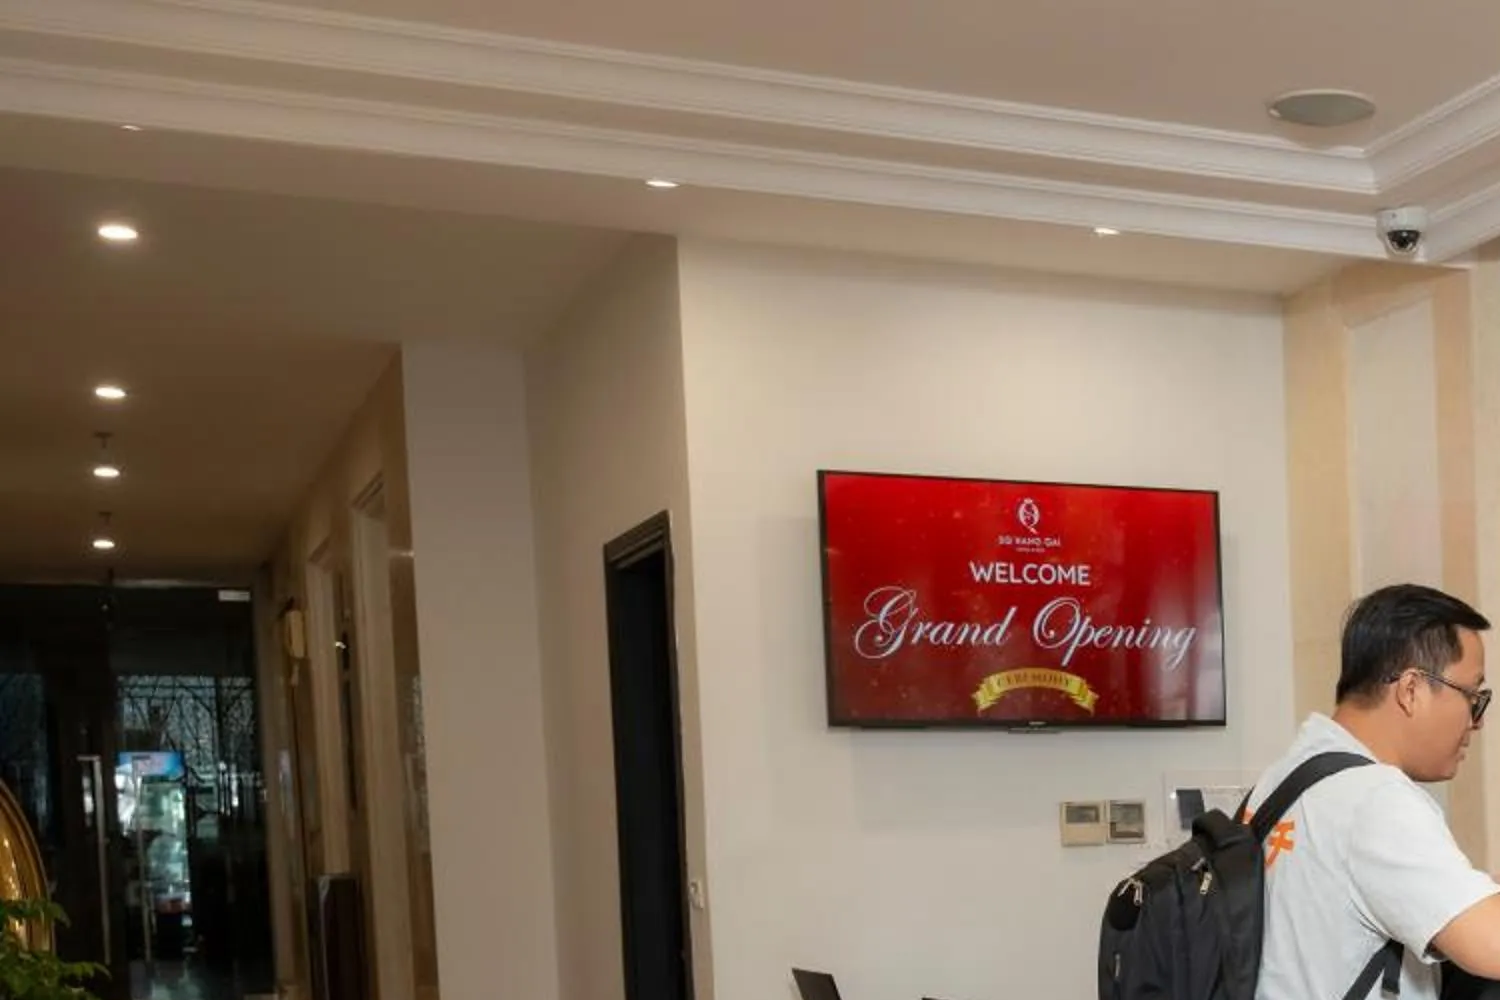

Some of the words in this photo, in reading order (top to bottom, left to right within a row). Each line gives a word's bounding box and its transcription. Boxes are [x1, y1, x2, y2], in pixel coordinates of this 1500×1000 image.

[969, 561, 1092, 586] WELCOME
[855, 586, 1017, 659] Grand
[1033, 597, 1197, 668] Opening
